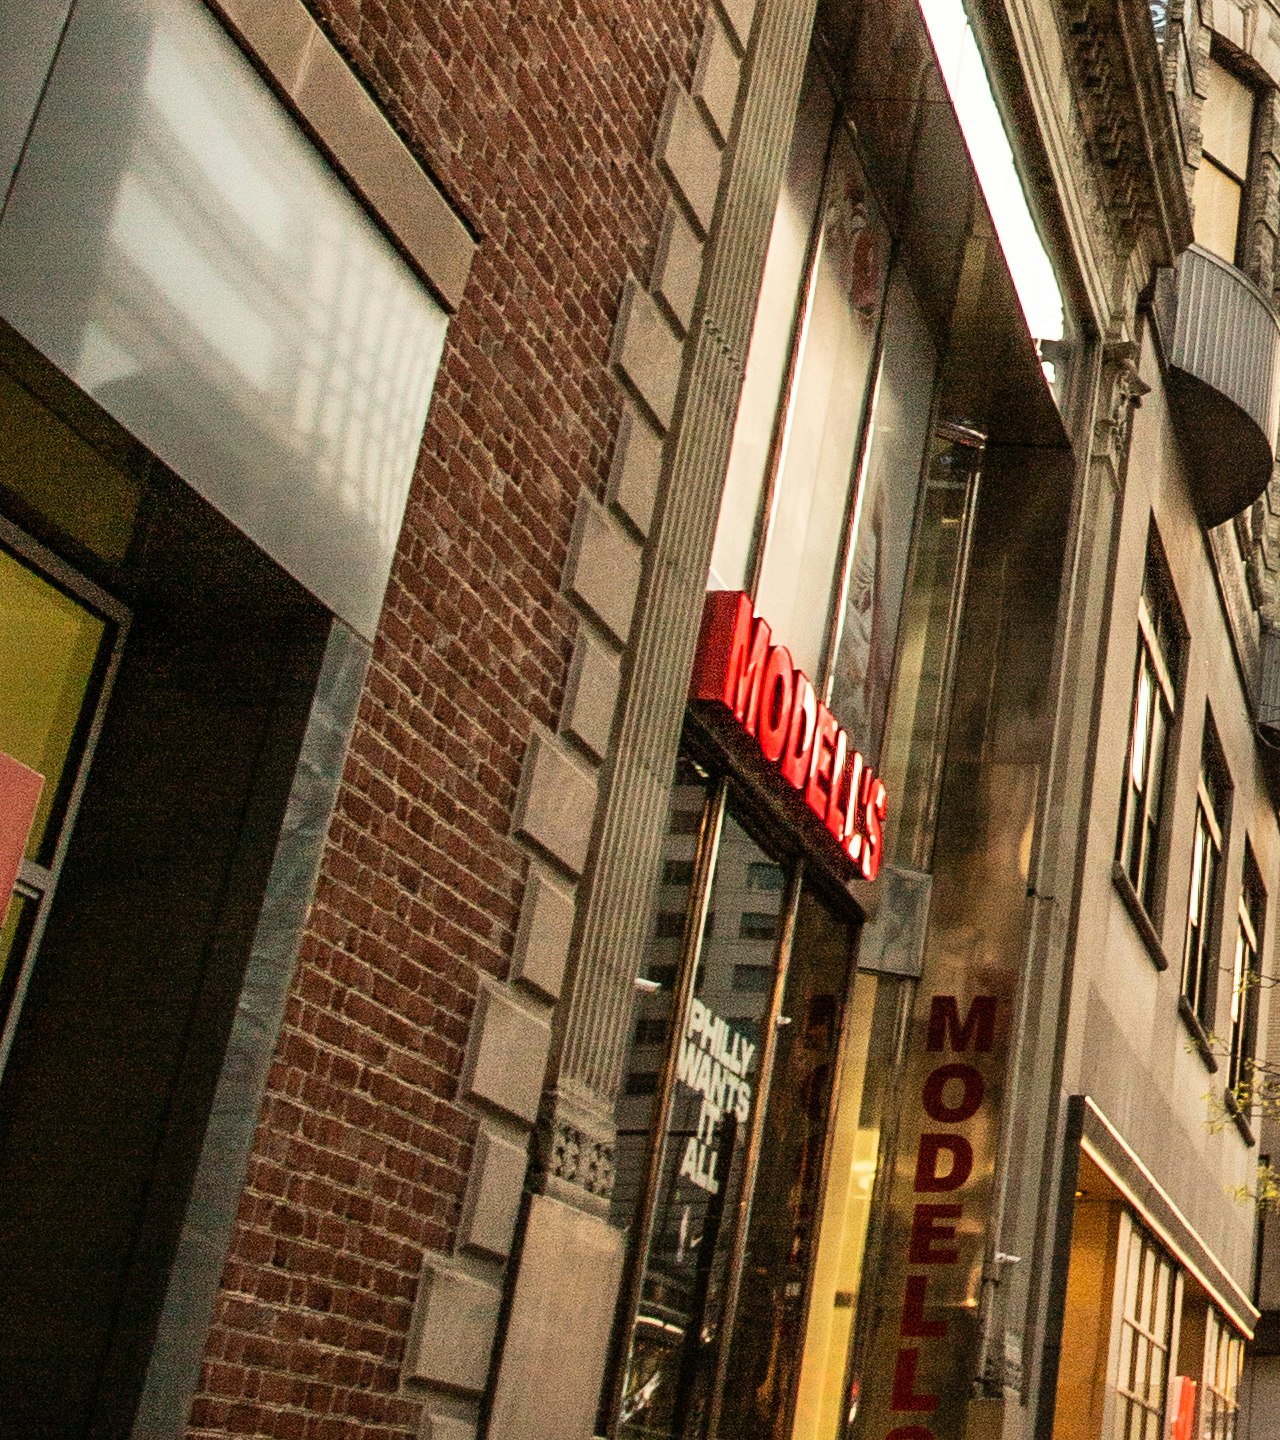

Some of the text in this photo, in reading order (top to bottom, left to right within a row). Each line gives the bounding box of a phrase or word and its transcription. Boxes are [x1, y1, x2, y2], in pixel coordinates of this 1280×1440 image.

[722, 590, 887, 882] MODELL'S
[687, 997, 755, 1078] PHILLY
[676, 1037, 750, 1123] WANTS
[697, 1099, 722, 1145] IT
[680, 1136, 719, 1194] ALL
